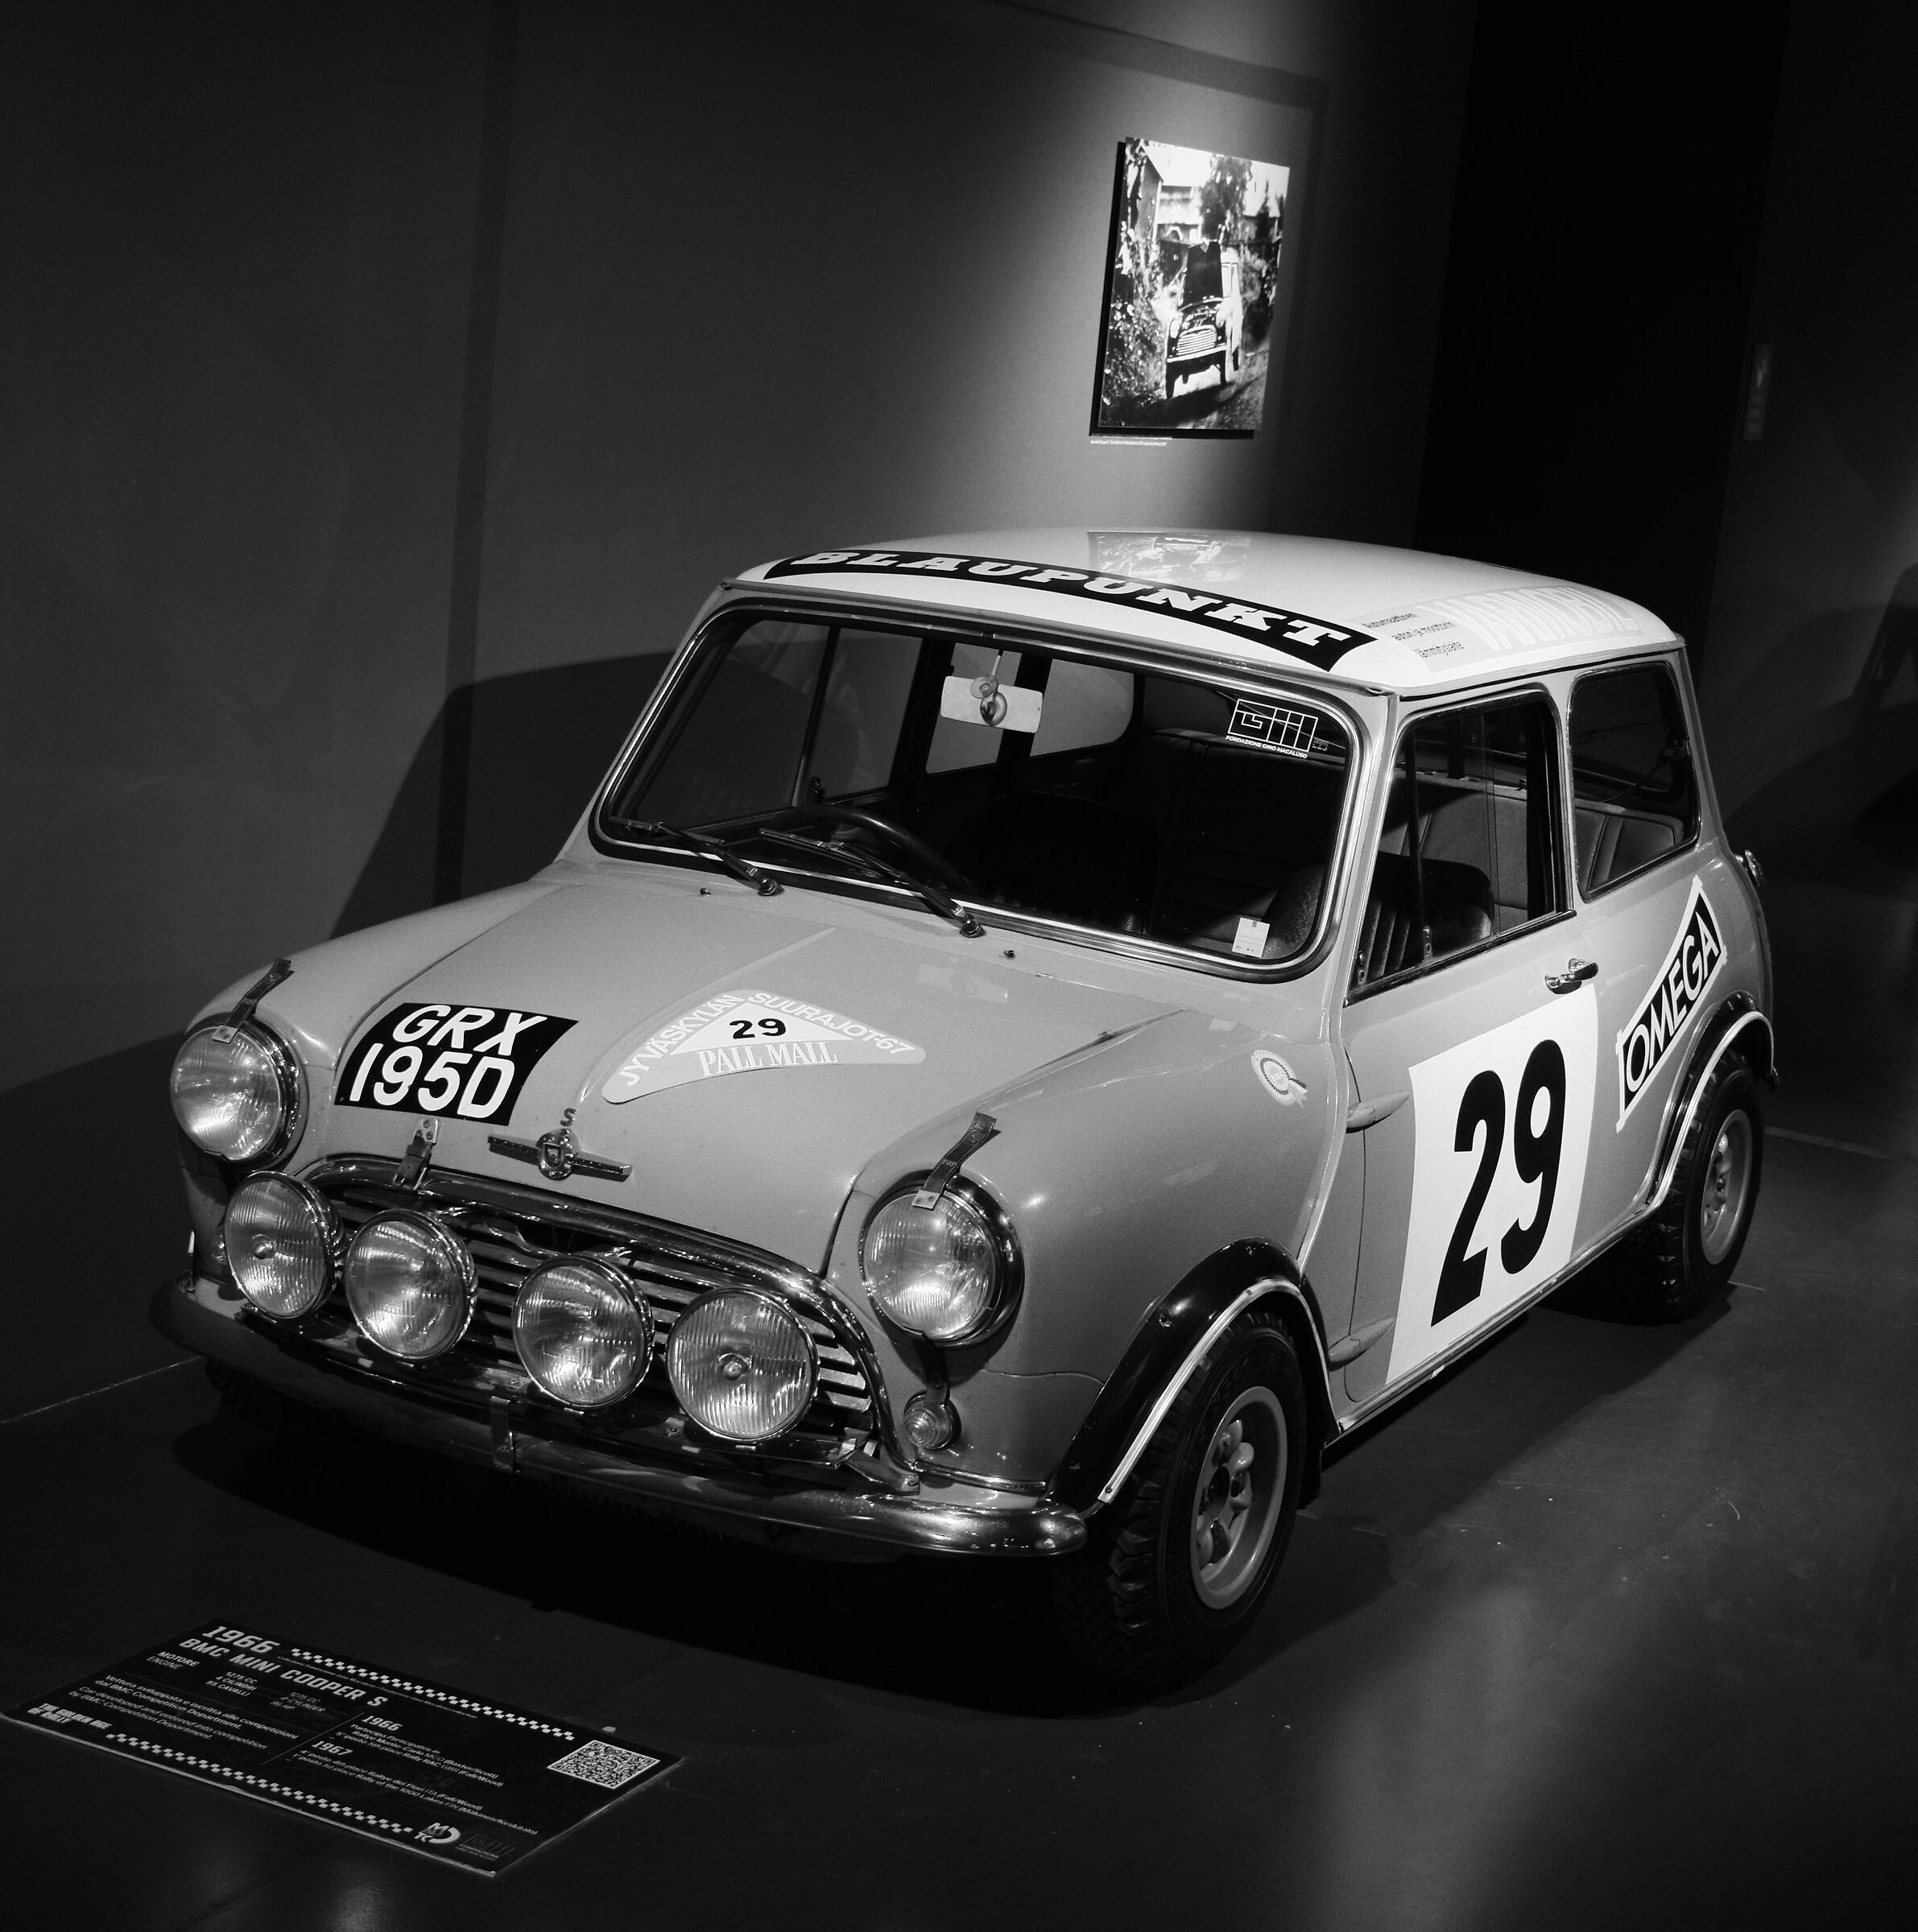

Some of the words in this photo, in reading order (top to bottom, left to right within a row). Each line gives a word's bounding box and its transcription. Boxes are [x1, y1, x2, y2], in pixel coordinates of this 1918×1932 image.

[790, 552, 1350, 647] BLAUPUNKT
[1226, 735, 1267, 749] FONDAZIONE
[1262, 743, 1277, 753] GINO
[1276, 747, 1308, 761] MACALUSO
[1626, 911, 1719, 1092] OMEGA
[392, 1005, 548, 1057] GRX
[618, 994, 745, 1086] JYVÄSKYLÄN
[747, 993, 916, 1054] SUURAJOT-67
[729, 1018, 787, 1039] 29
[697, 1045, 762, 1077] PALL
[764, 1042, 838, 1067] MALL
[349, 1042, 515, 1118] 195D
[560, 1108, 577, 1127] S
[1430, 1040, 1566, 1328] 29
[202, 1625, 280, 1653] 1966
[146, 1656, 184, 1670] ENGINE
[157, 1651, 200, 1667] MOTORE
[179, 1638, 230, 1657] BMC
[229, 1653, 281, 1674] MINI
[280, 1670, 366, 1700] COOPER
[366, 1696, 389, 1707] S
[222, 1678, 258, 1691] CILINDRI
[217, 1683, 251, 1697] CAVALLI
[38, 1703, 60, 1712] THE
[56, 1708, 93, 1724] GOLDEN
[89, 1719, 113, 1730] AGE
[40, 1711, 72, 1724] RALLY
[362, 1715, 403, 1732] 1966
[312, 1740, 353, 1756] 1967
